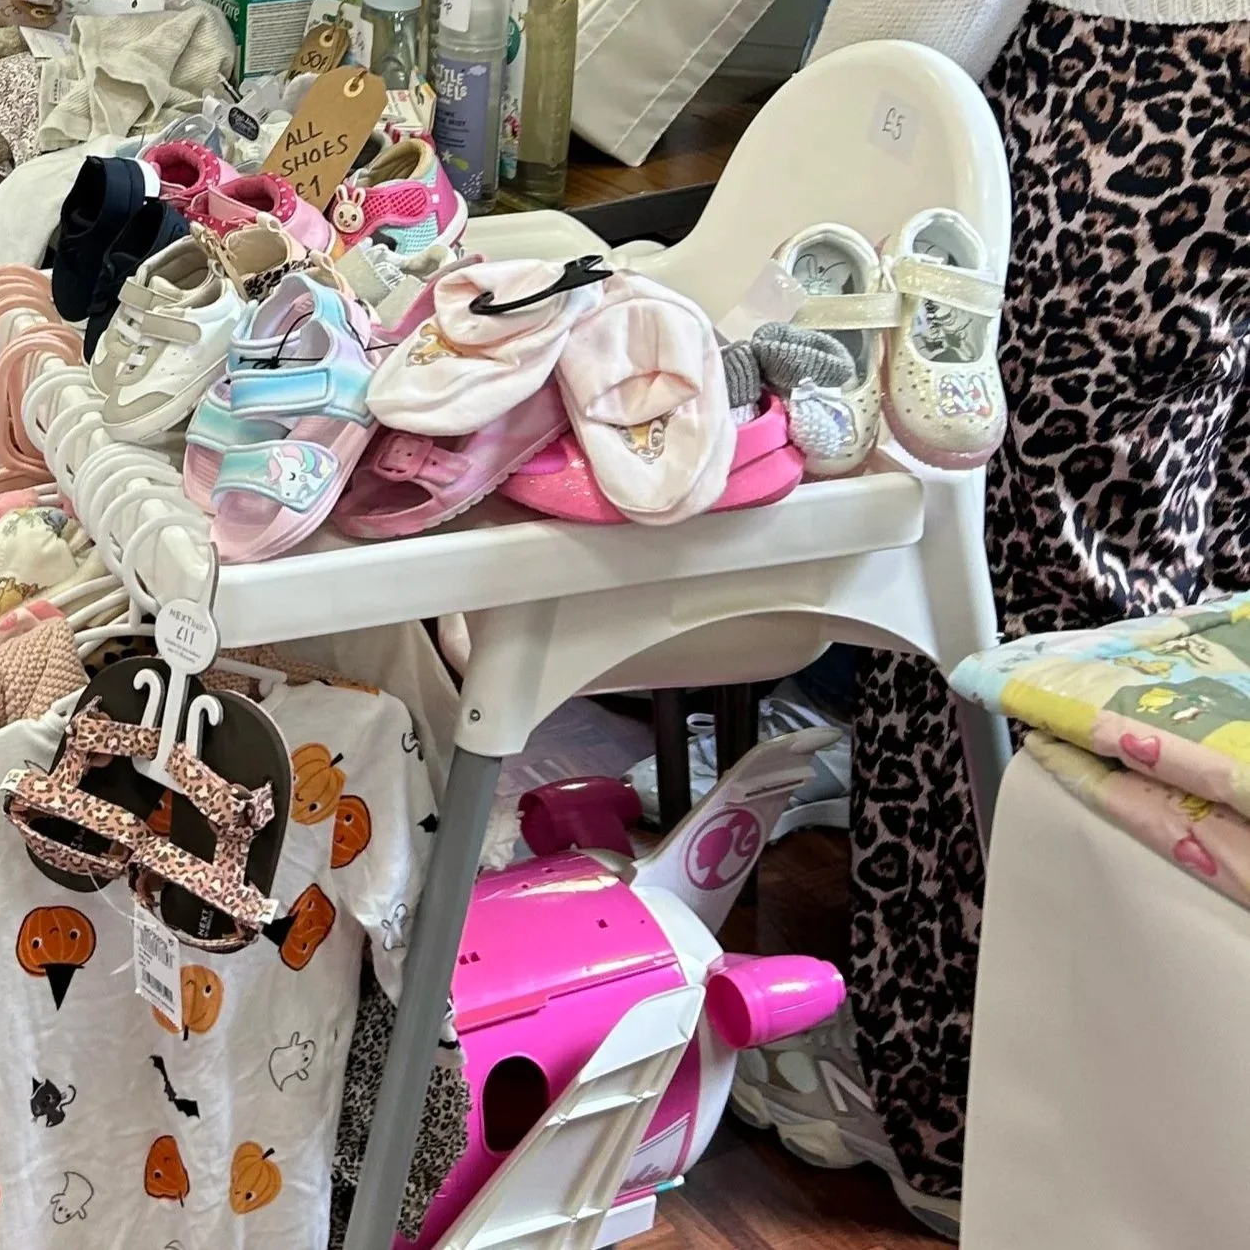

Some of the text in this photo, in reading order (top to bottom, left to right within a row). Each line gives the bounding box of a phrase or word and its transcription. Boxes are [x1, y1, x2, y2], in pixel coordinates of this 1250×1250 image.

[285, 121, 324, 152] ALL
[882, 106, 905, 141] £5
[280, 133, 349, 178] SHOES
